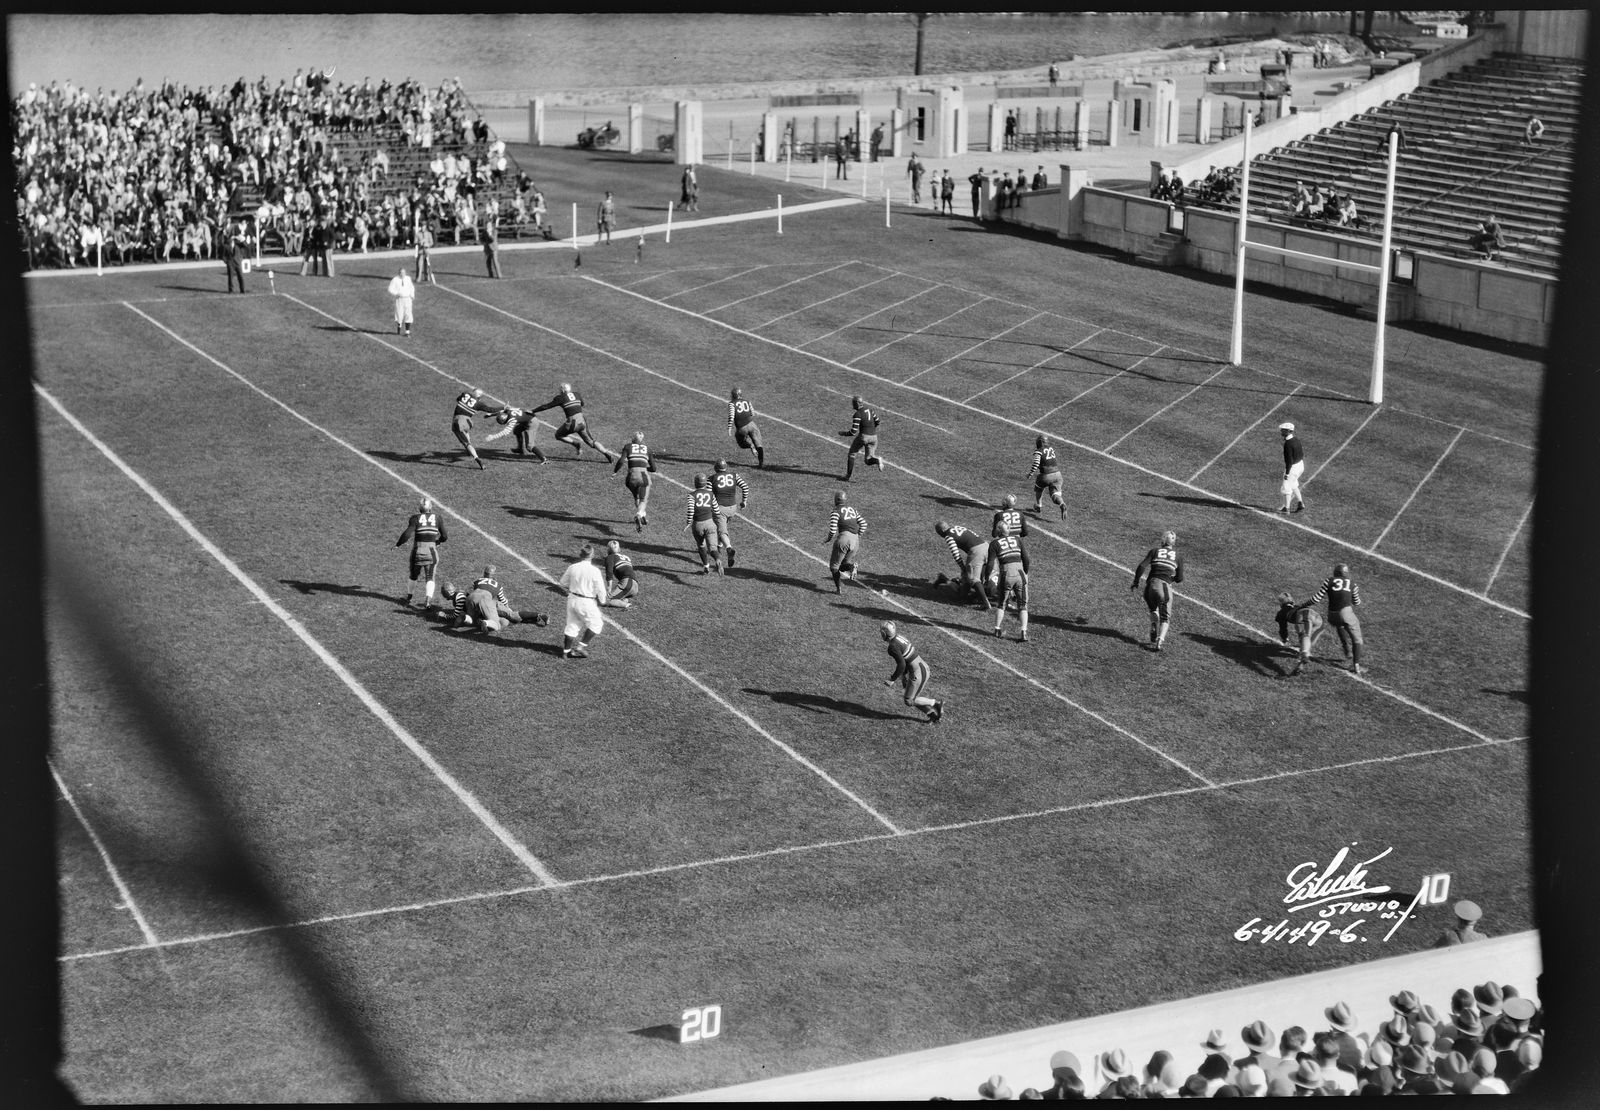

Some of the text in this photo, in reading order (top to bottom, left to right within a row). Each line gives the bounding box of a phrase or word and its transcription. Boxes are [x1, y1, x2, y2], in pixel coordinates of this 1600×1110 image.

[461, 393, 477, 408] 33
[735, 400, 749, 413] 30
[864, 409, 871, 421] 7
[631, 443, 648, 454] 23
[1043, 446, 1056, 460] 23
[717, 473, 734, 488] 36
[695, 492, 711, 508] 32
[840, 506, 857, 520] 29
[1002, 512, 1021, 524] 22
[418, 514, 436, 527] 44
[997, 536, 1017, 550] 55
[1331, 578, 1351, 592] 31
[1420, 874, 1451, 905] 10
[681, 1004, 722, 1043] 20
